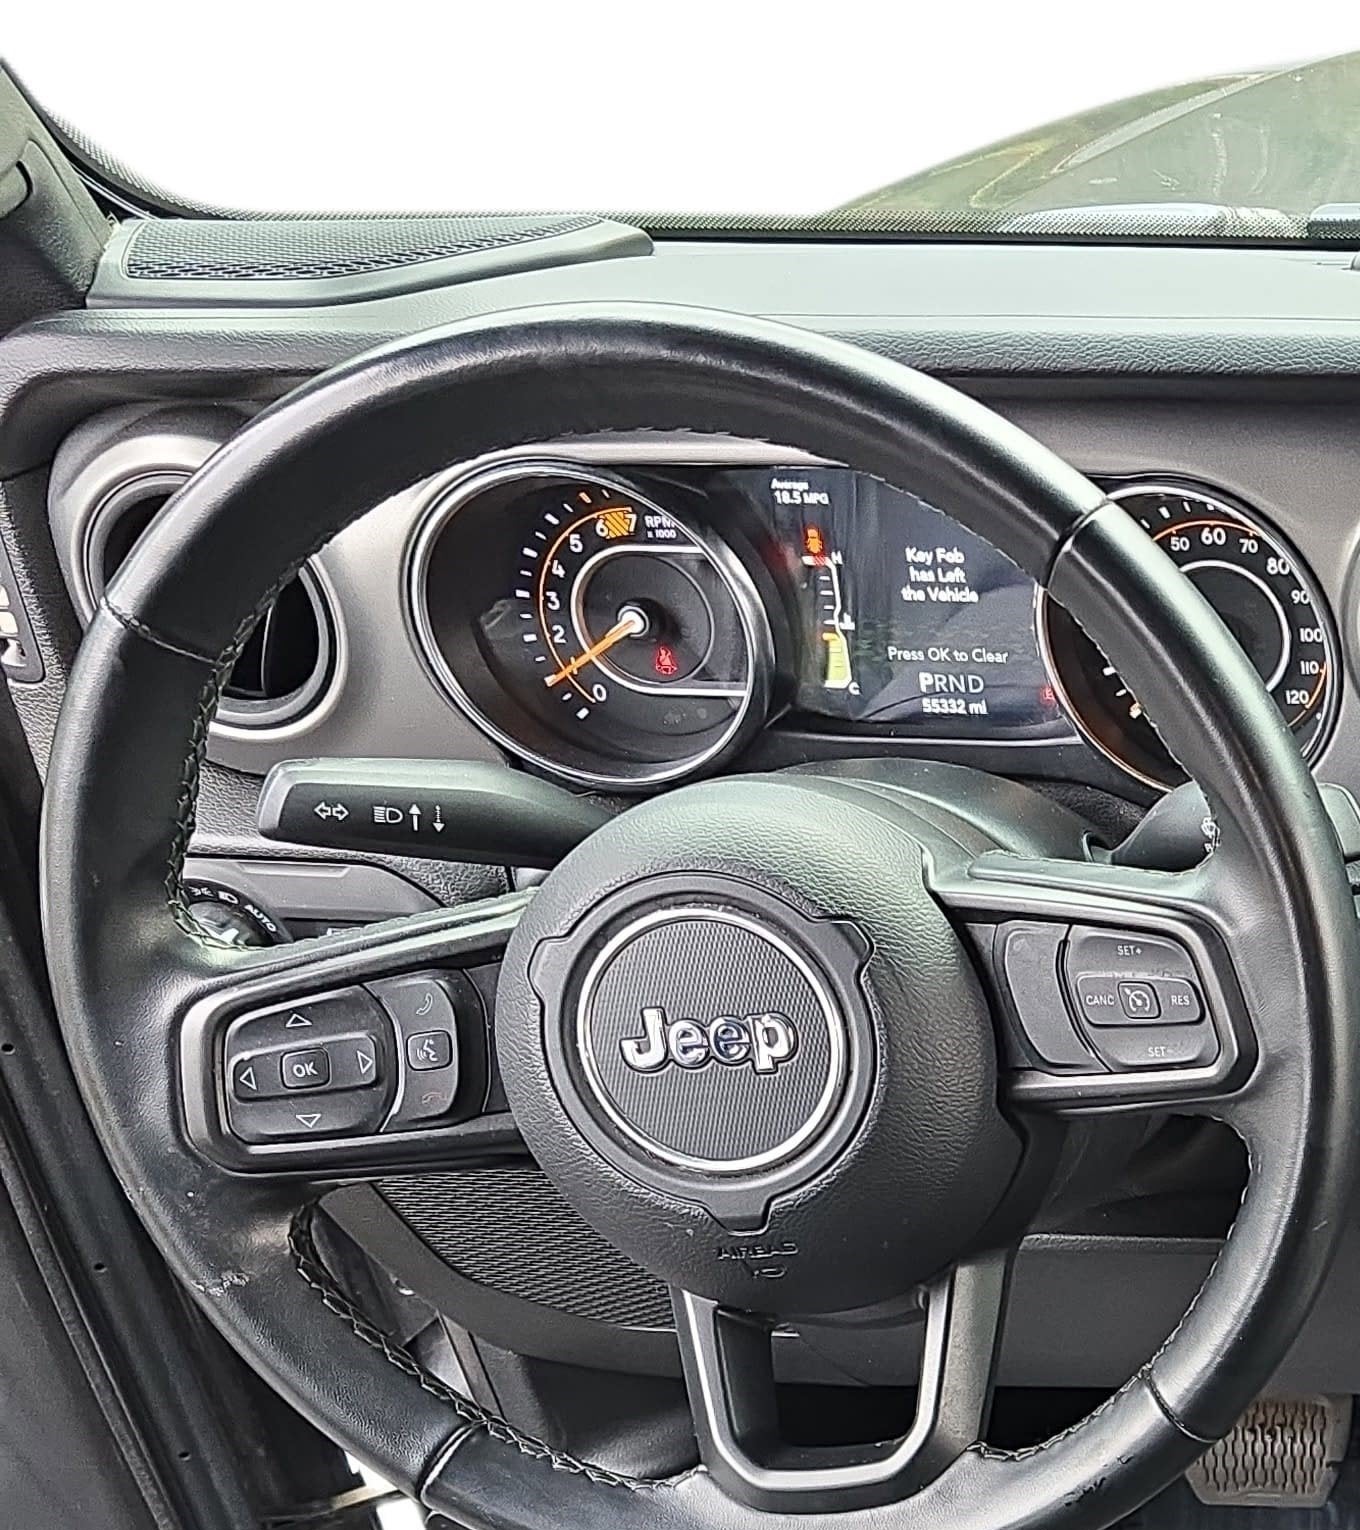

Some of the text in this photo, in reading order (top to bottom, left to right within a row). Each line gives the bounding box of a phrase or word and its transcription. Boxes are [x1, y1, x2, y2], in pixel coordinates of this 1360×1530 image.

[773, 490, 829, 505] 18.5 MPG
[595, 519, 609, 537] 6
[624, 513, 638, 533] 7
[655, 529, 677, 539] 1000
[1200, 527, 1227, 546] 60
[568, 533, 584, 554] 5
[1169, 536, 1191, 551] 50
[1238, 538, 1259, 554] 70
[831, 550, 844, 566] H
[905, 546, 965, 565] Key Fob
[550, 557, 566, 579] 4
[909, 566, 967, 584] has Left
[1265, 556, 1291, 576] 80
[546, 590, 561, 611] 3
[900, 586, 980, 604] the Vehicle
[1290, 589, 1311, 606] 90
[552, 624, 567, 645] 2
[1299, 627, 1324, 644] 100
[887, 645, 1010, 665] Press OK to Clear
[1299, 659, 1319, 676] 110
[918, 671, 985, 695] PRND
[592, 683, 608, 702] 0
[1286, 689, 1311, 707] 120
[921, 699, 988, 716] 55332 mi
[243, 903, 278, 934] AUTO
[1084, 994, 1116, 1006] CANC
[1170, 994, 1191, 1006] RES
[619, 1005, 801, 1077] Jeep
[292, 1062, 318, 1080] OK
